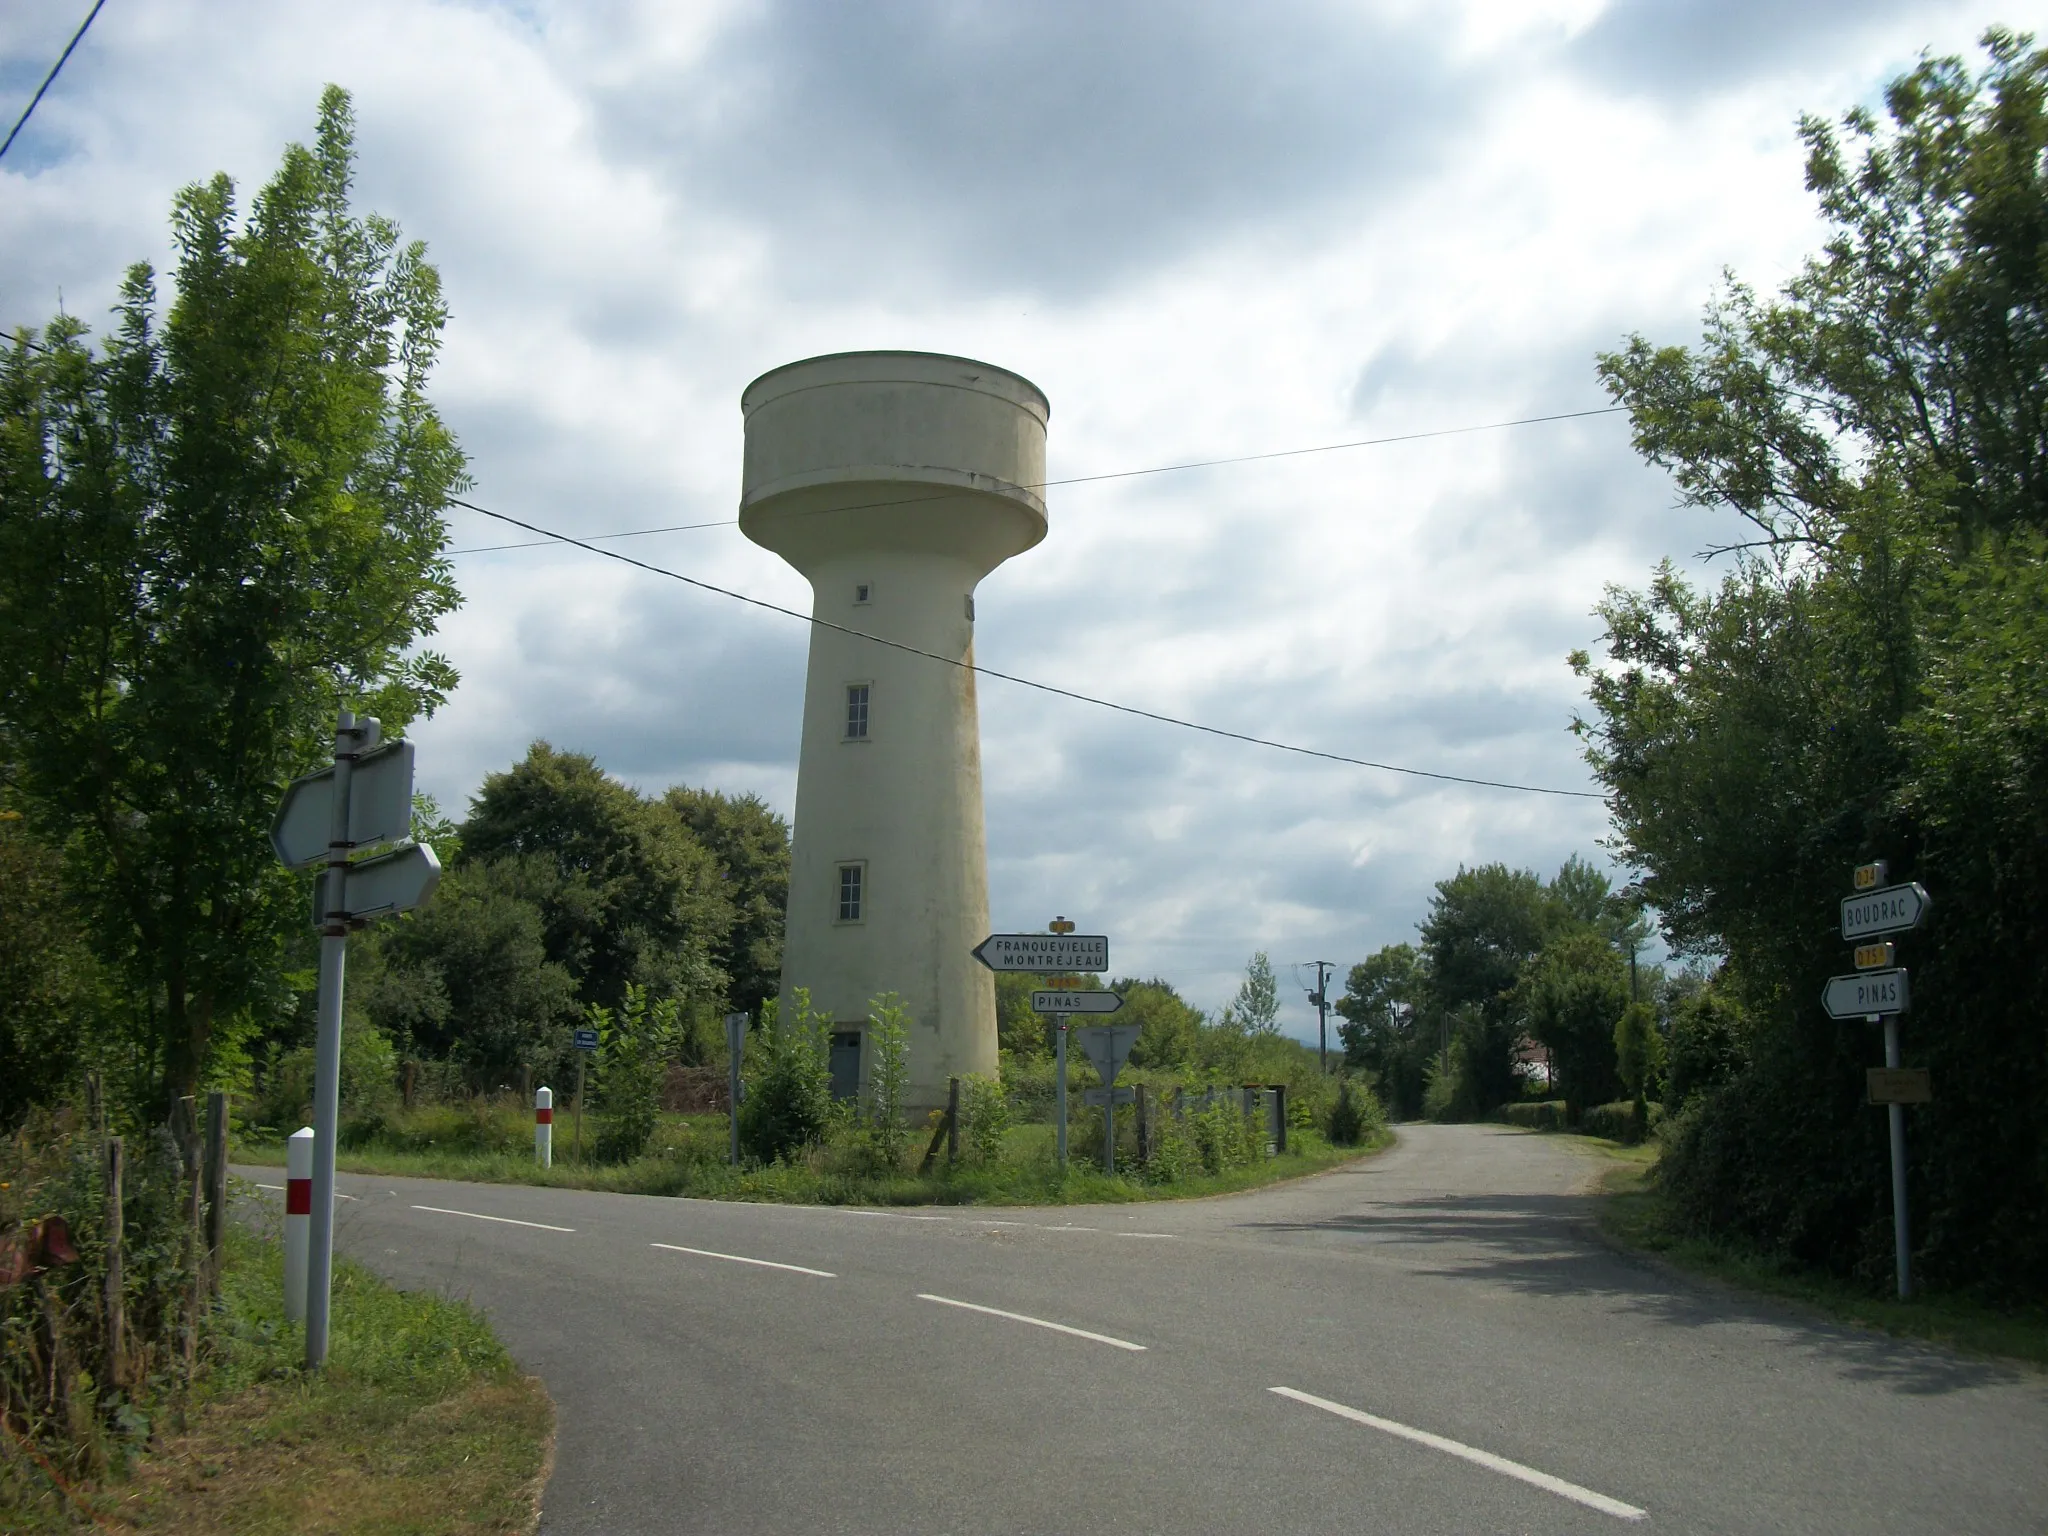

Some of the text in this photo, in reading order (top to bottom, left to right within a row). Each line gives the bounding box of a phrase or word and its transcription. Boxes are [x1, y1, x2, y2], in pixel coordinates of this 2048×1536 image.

[1847, 898, 1905, 927] BOUDRAC
[996, 941, 1102, 953] FRANQUEVIELLE
[1004, 953, 1102, 966] MONTRÉJEAU
[1858, 983, 1896, 1005] PINAS
[1038, 996, 1081, 1007] PINAS
